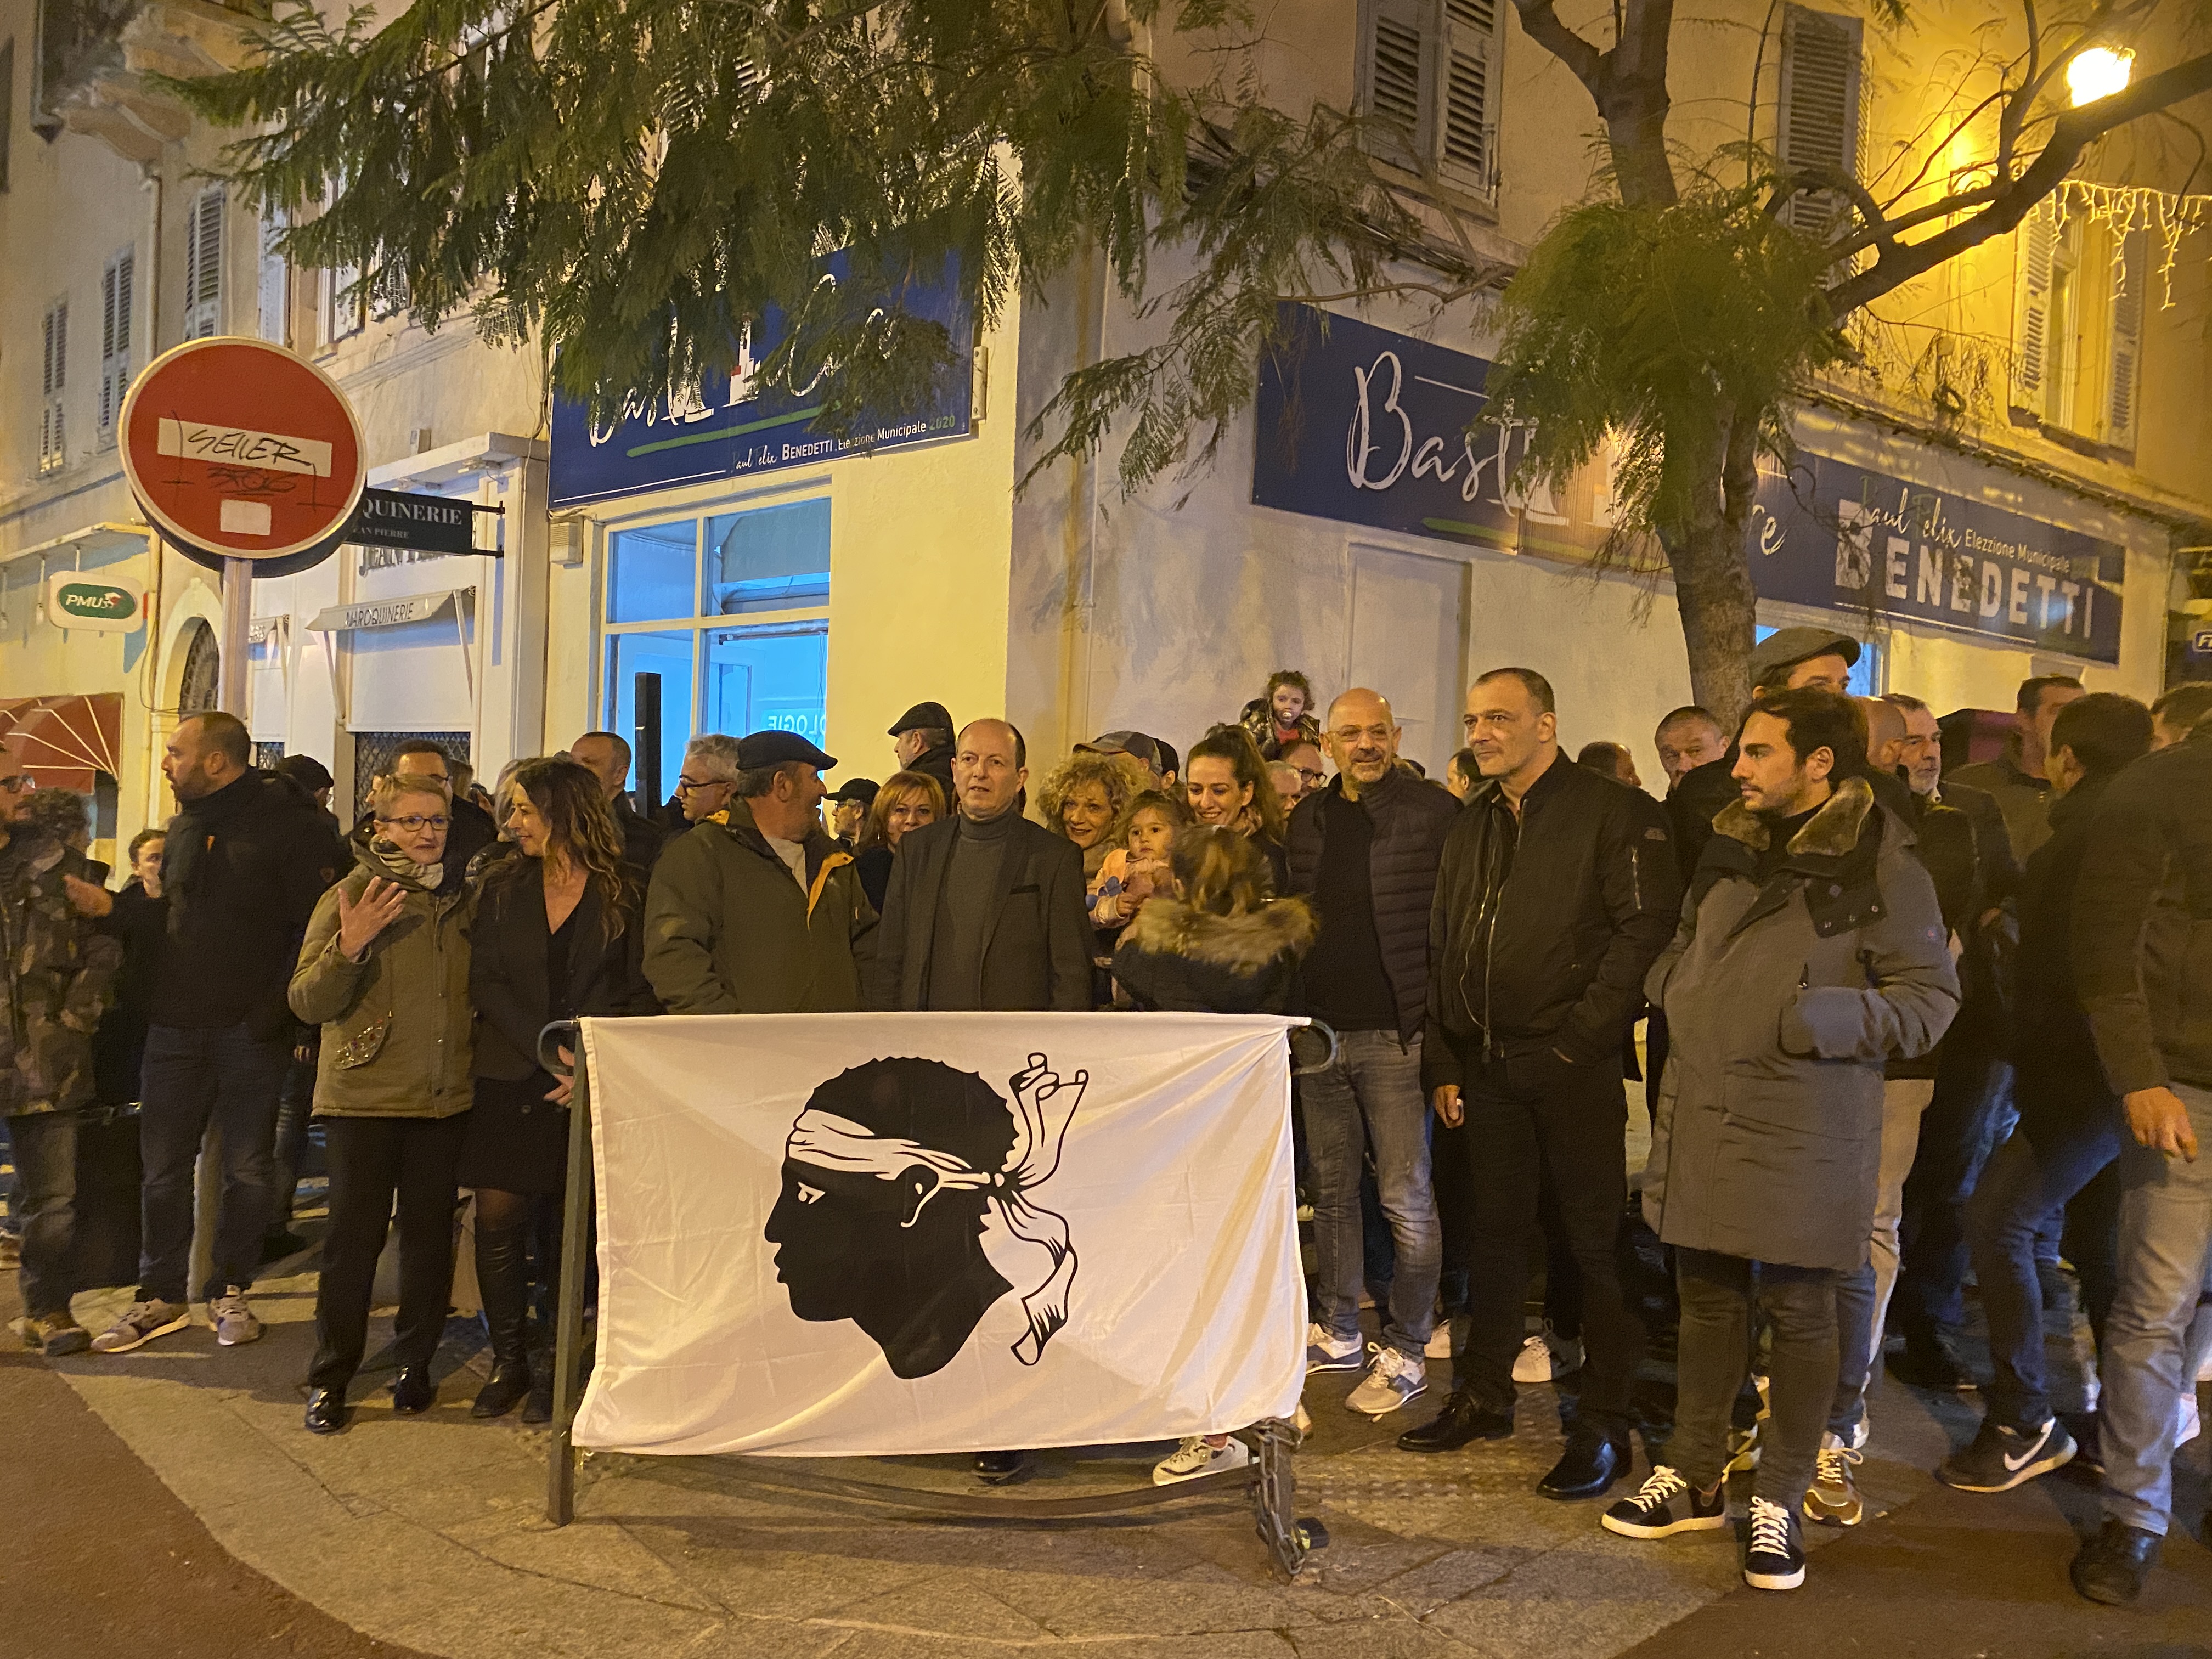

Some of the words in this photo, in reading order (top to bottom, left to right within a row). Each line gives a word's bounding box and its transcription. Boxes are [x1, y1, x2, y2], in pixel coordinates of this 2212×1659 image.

[878, 420, 927, 441] Municipale
[929, 415, 956, 431] 2020
[363, 498, 462, 526] QUINERIE
[375, 528, 410, 540] PIERRE
[1965, 528, 2016, 558] Elezzione
[1835, 499, 2094, 639] BENEDETTI
[65, 594, 104, 608] PMU
[345, 602, 414, 627] MAROQUINERIE
